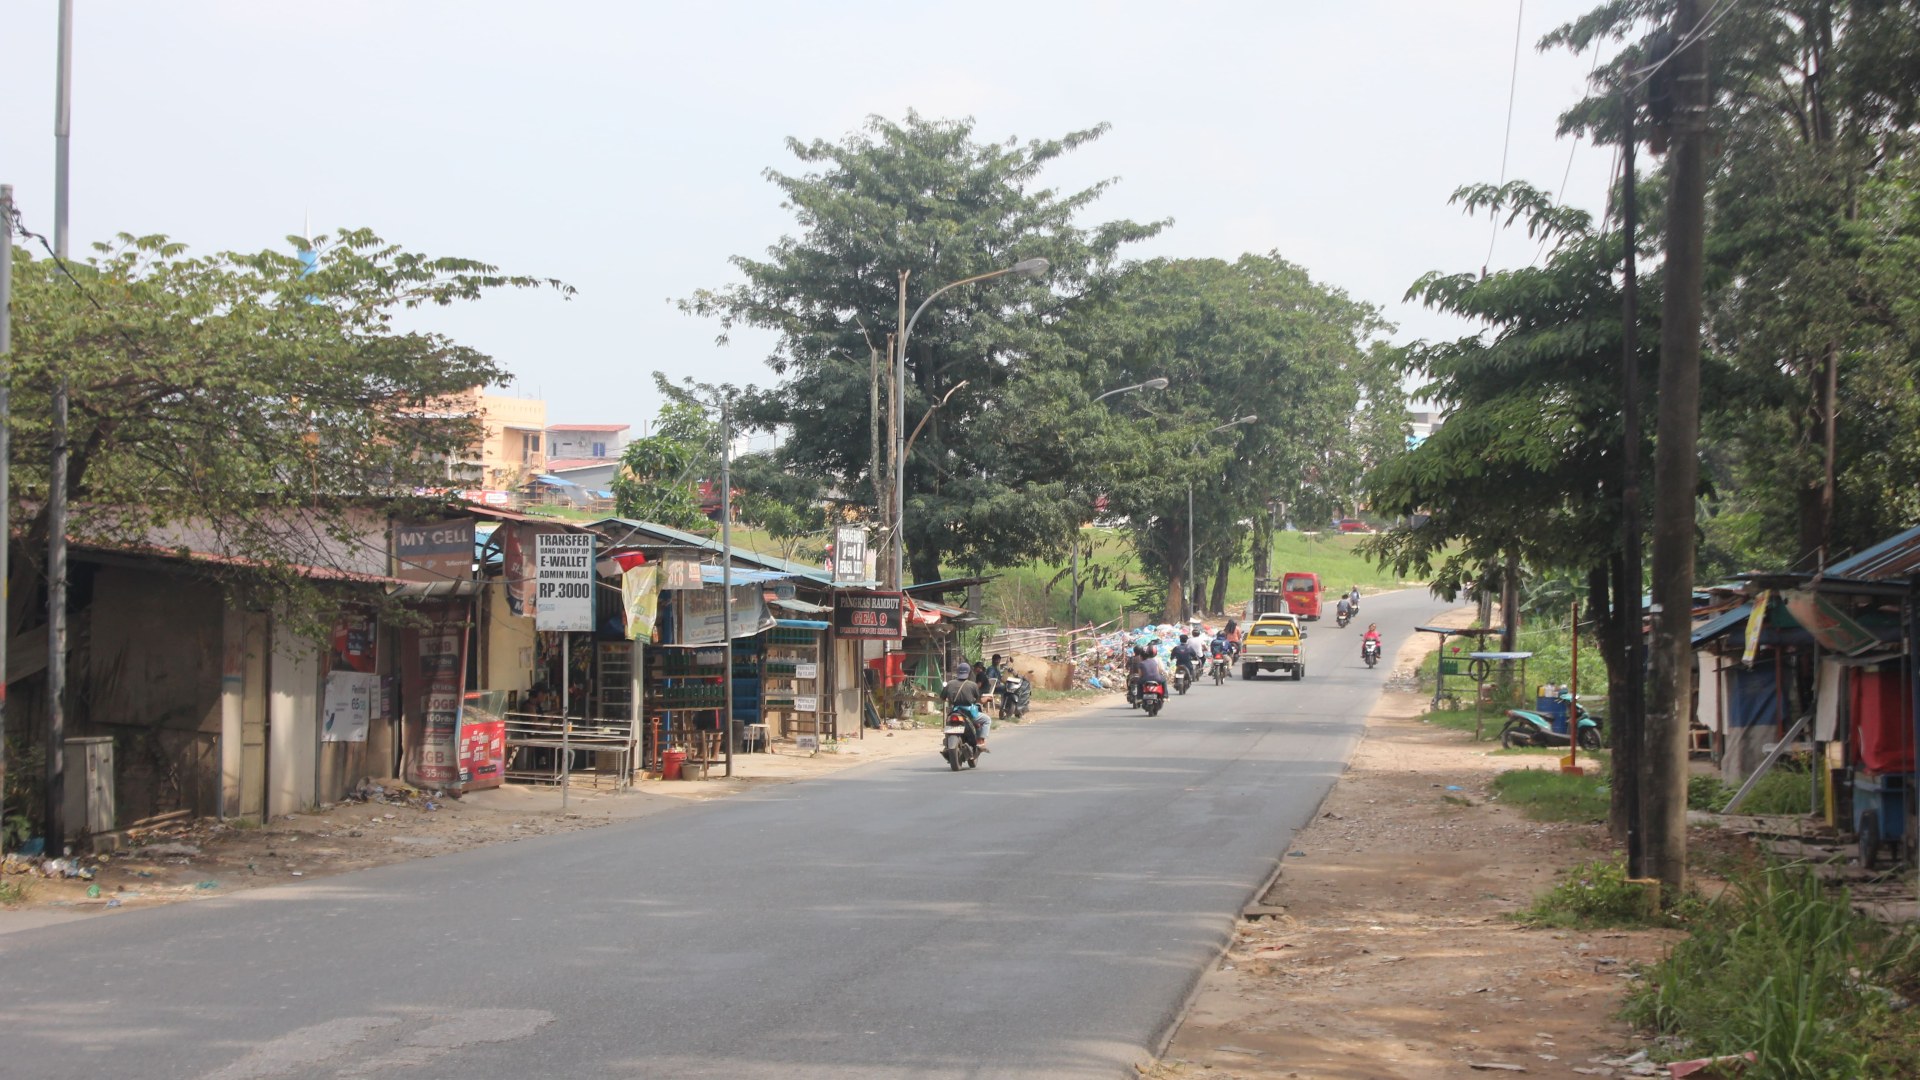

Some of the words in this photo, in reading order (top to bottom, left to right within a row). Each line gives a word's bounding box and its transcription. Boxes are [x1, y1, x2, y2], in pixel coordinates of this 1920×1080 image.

[400, 531, 427, 546] MY
[432, 529, 469, 545] CELL
[539, 535, 589, 546] TRANSFER
[540, 556, 588, 567] E-WALLET
[539, 570, 564, 579] ADMIN
[565, 570, 589, 579] MULAI
[539, 583, 590, 598] RP.3000
[840, 597, 870, 608] PANGKAS
[871, 598, 900, 609] RAMBUT
[851, 611, 878, 625] GEA
[879, 612, 888, 627] 9
